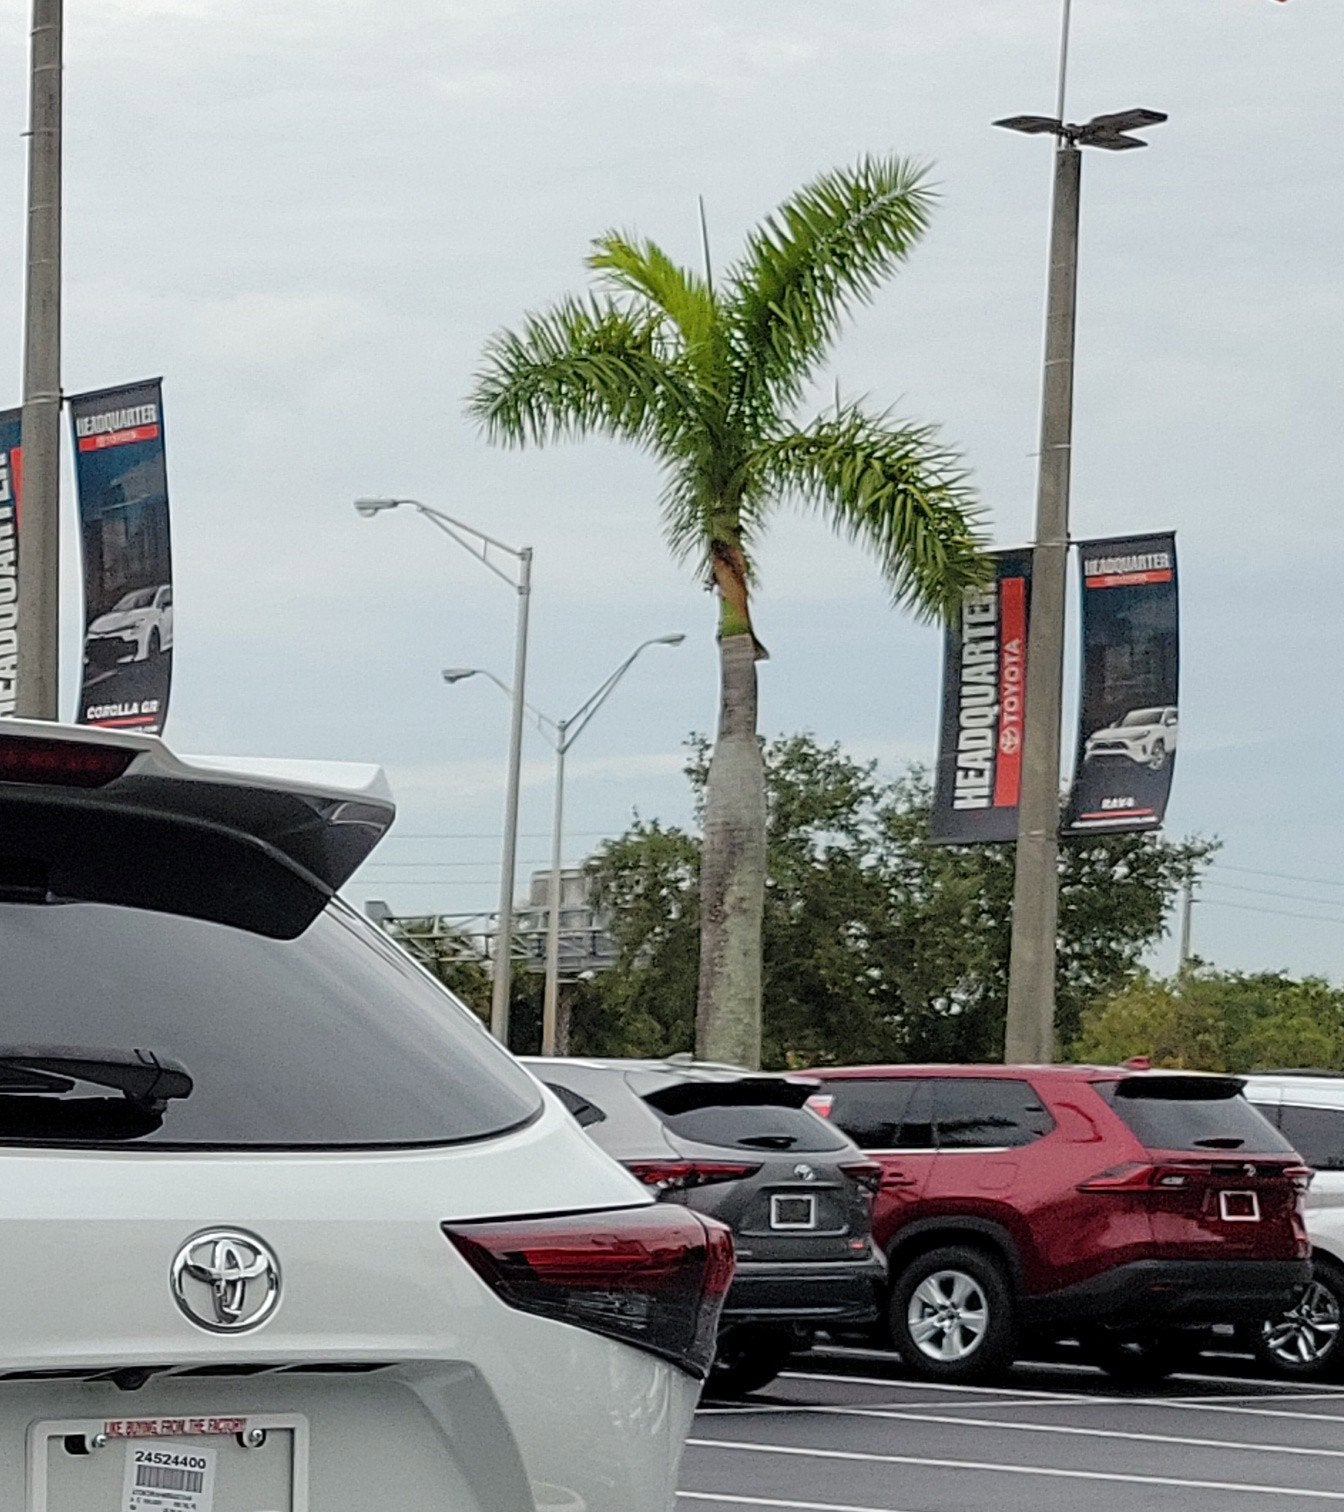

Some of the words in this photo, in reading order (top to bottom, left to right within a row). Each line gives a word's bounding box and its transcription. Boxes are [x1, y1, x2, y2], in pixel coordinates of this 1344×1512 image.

[1003, 637, 1022, 722] TOYOTA
[87, 702, 139, 719] COROLLA
[135, 1451, 206, 1469] 24524400
